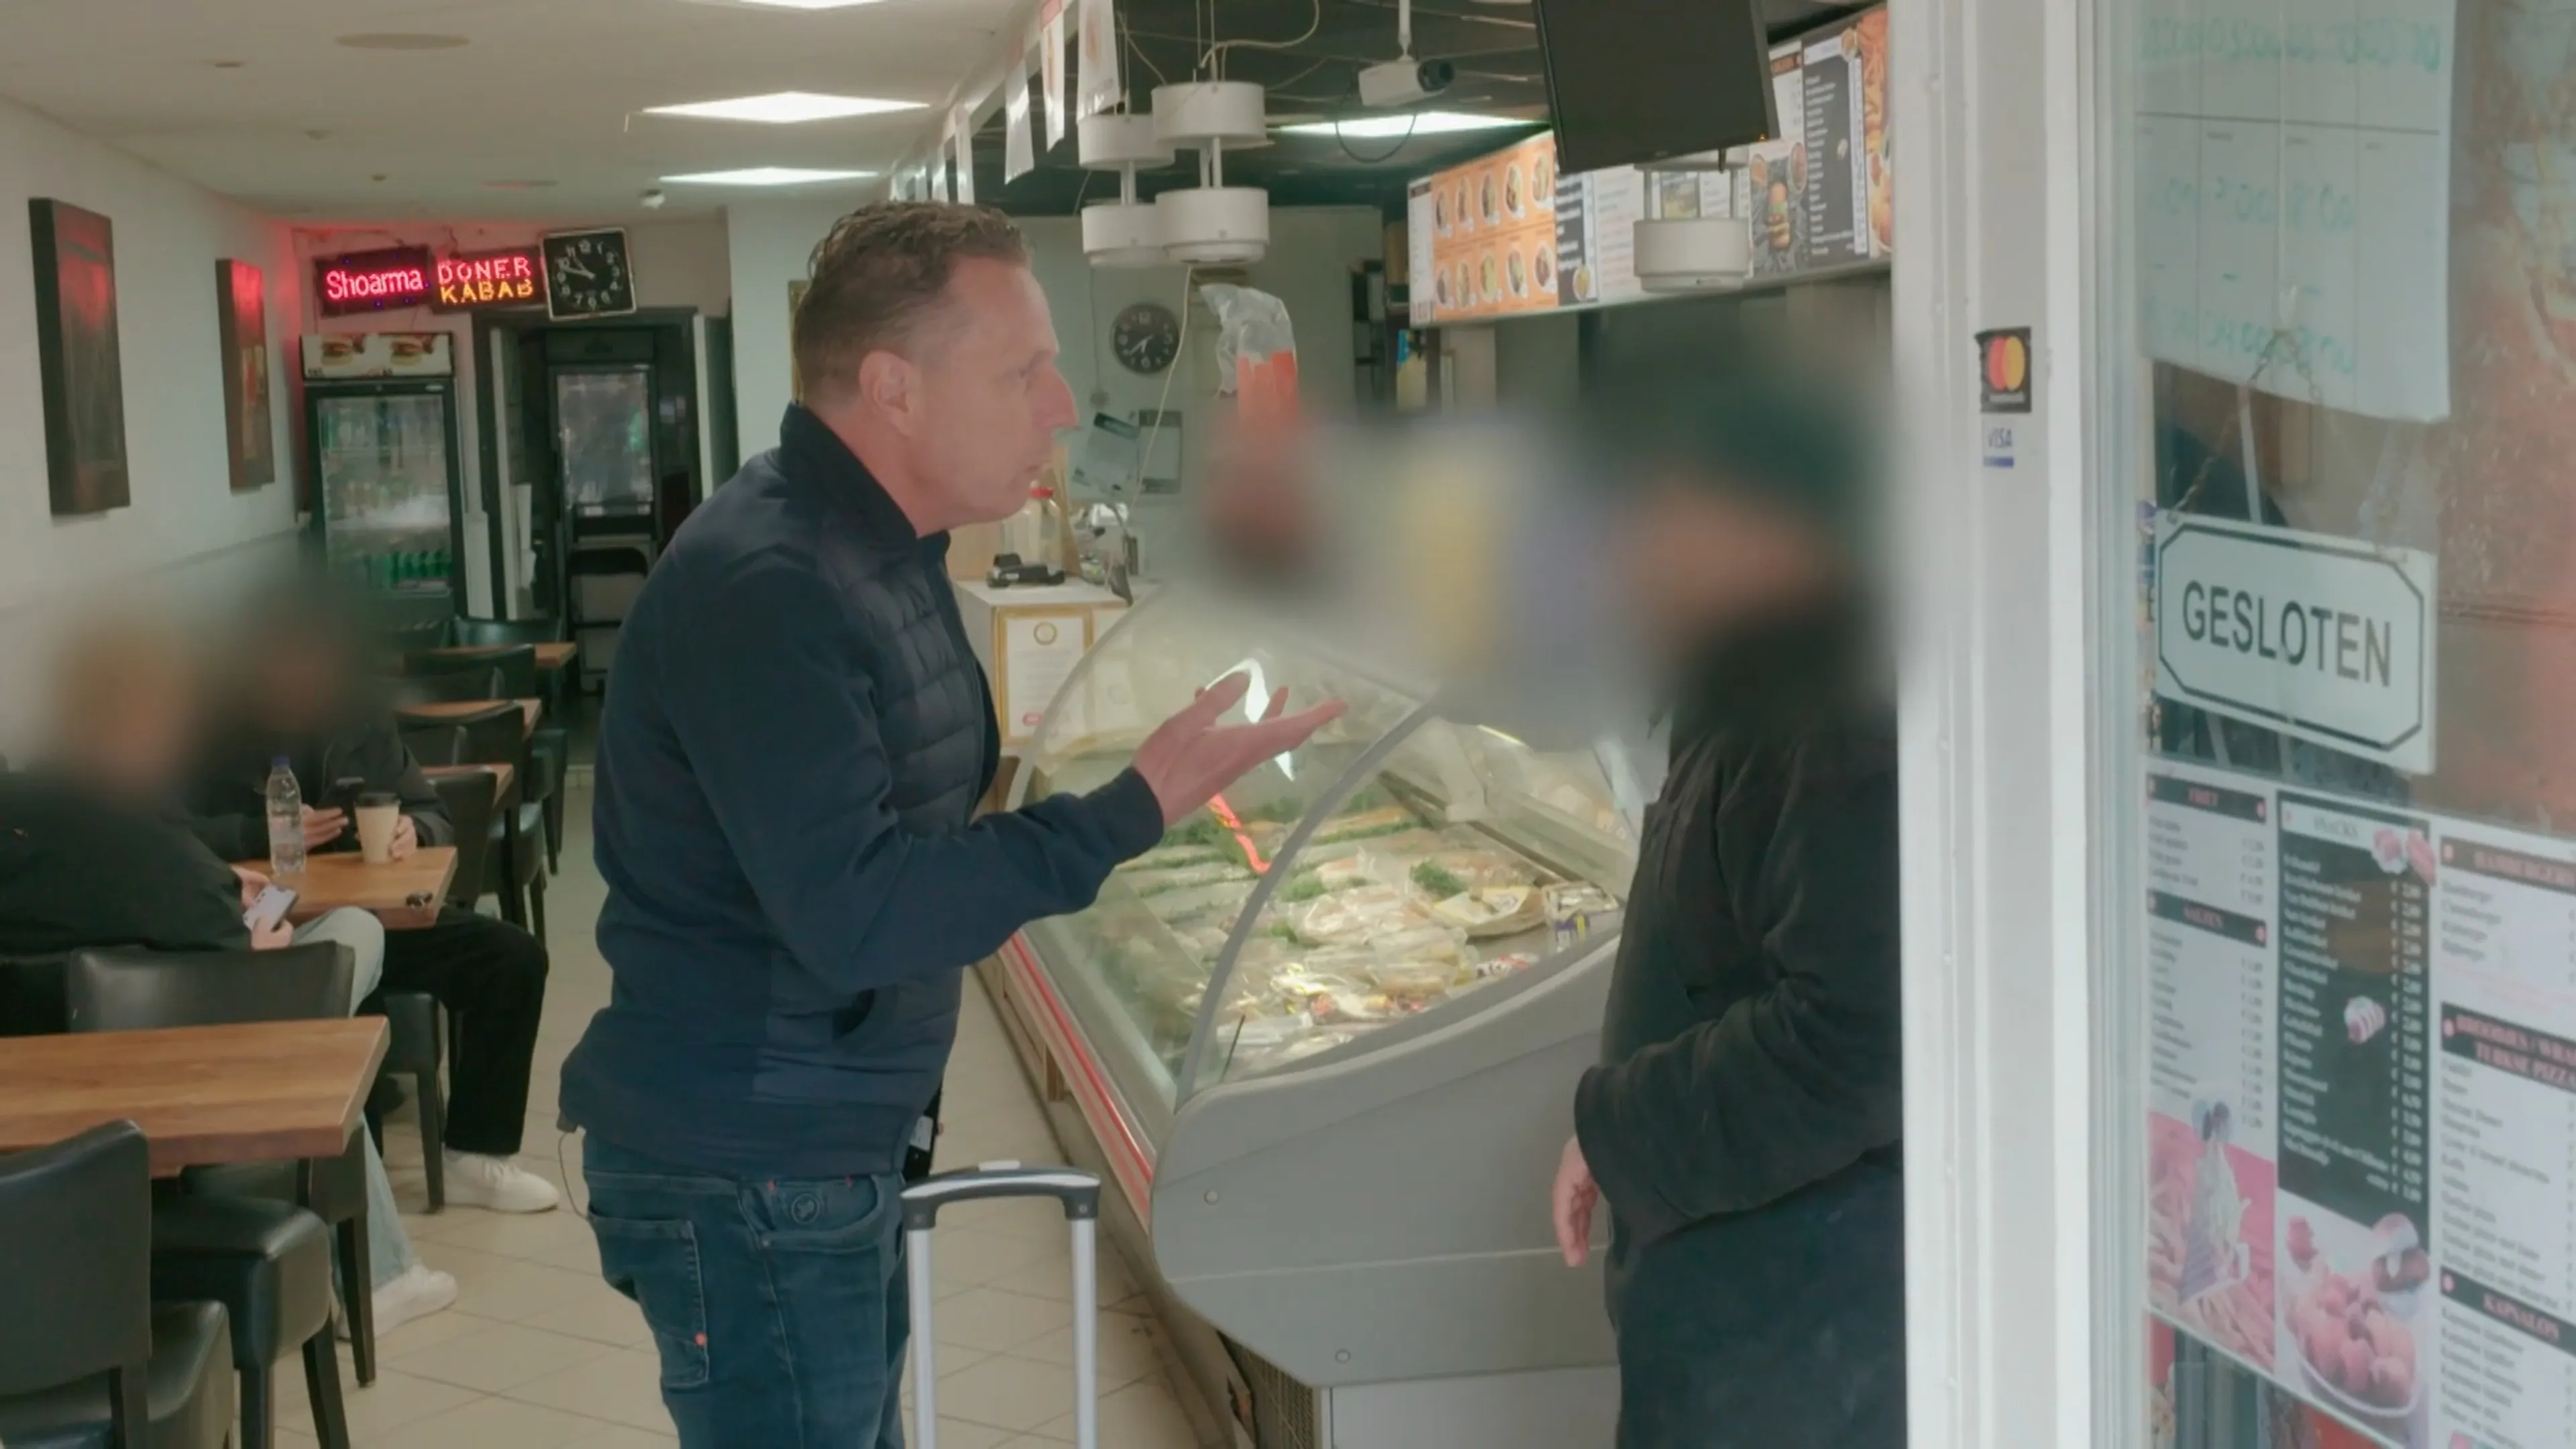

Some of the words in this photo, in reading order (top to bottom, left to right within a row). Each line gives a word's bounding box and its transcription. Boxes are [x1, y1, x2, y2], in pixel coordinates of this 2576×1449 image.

[327, 269, 423, 299] Shoarma
[440, 278, 533, 303] KABAB
[2183, 580, 2391, 687] GESLOTEN
